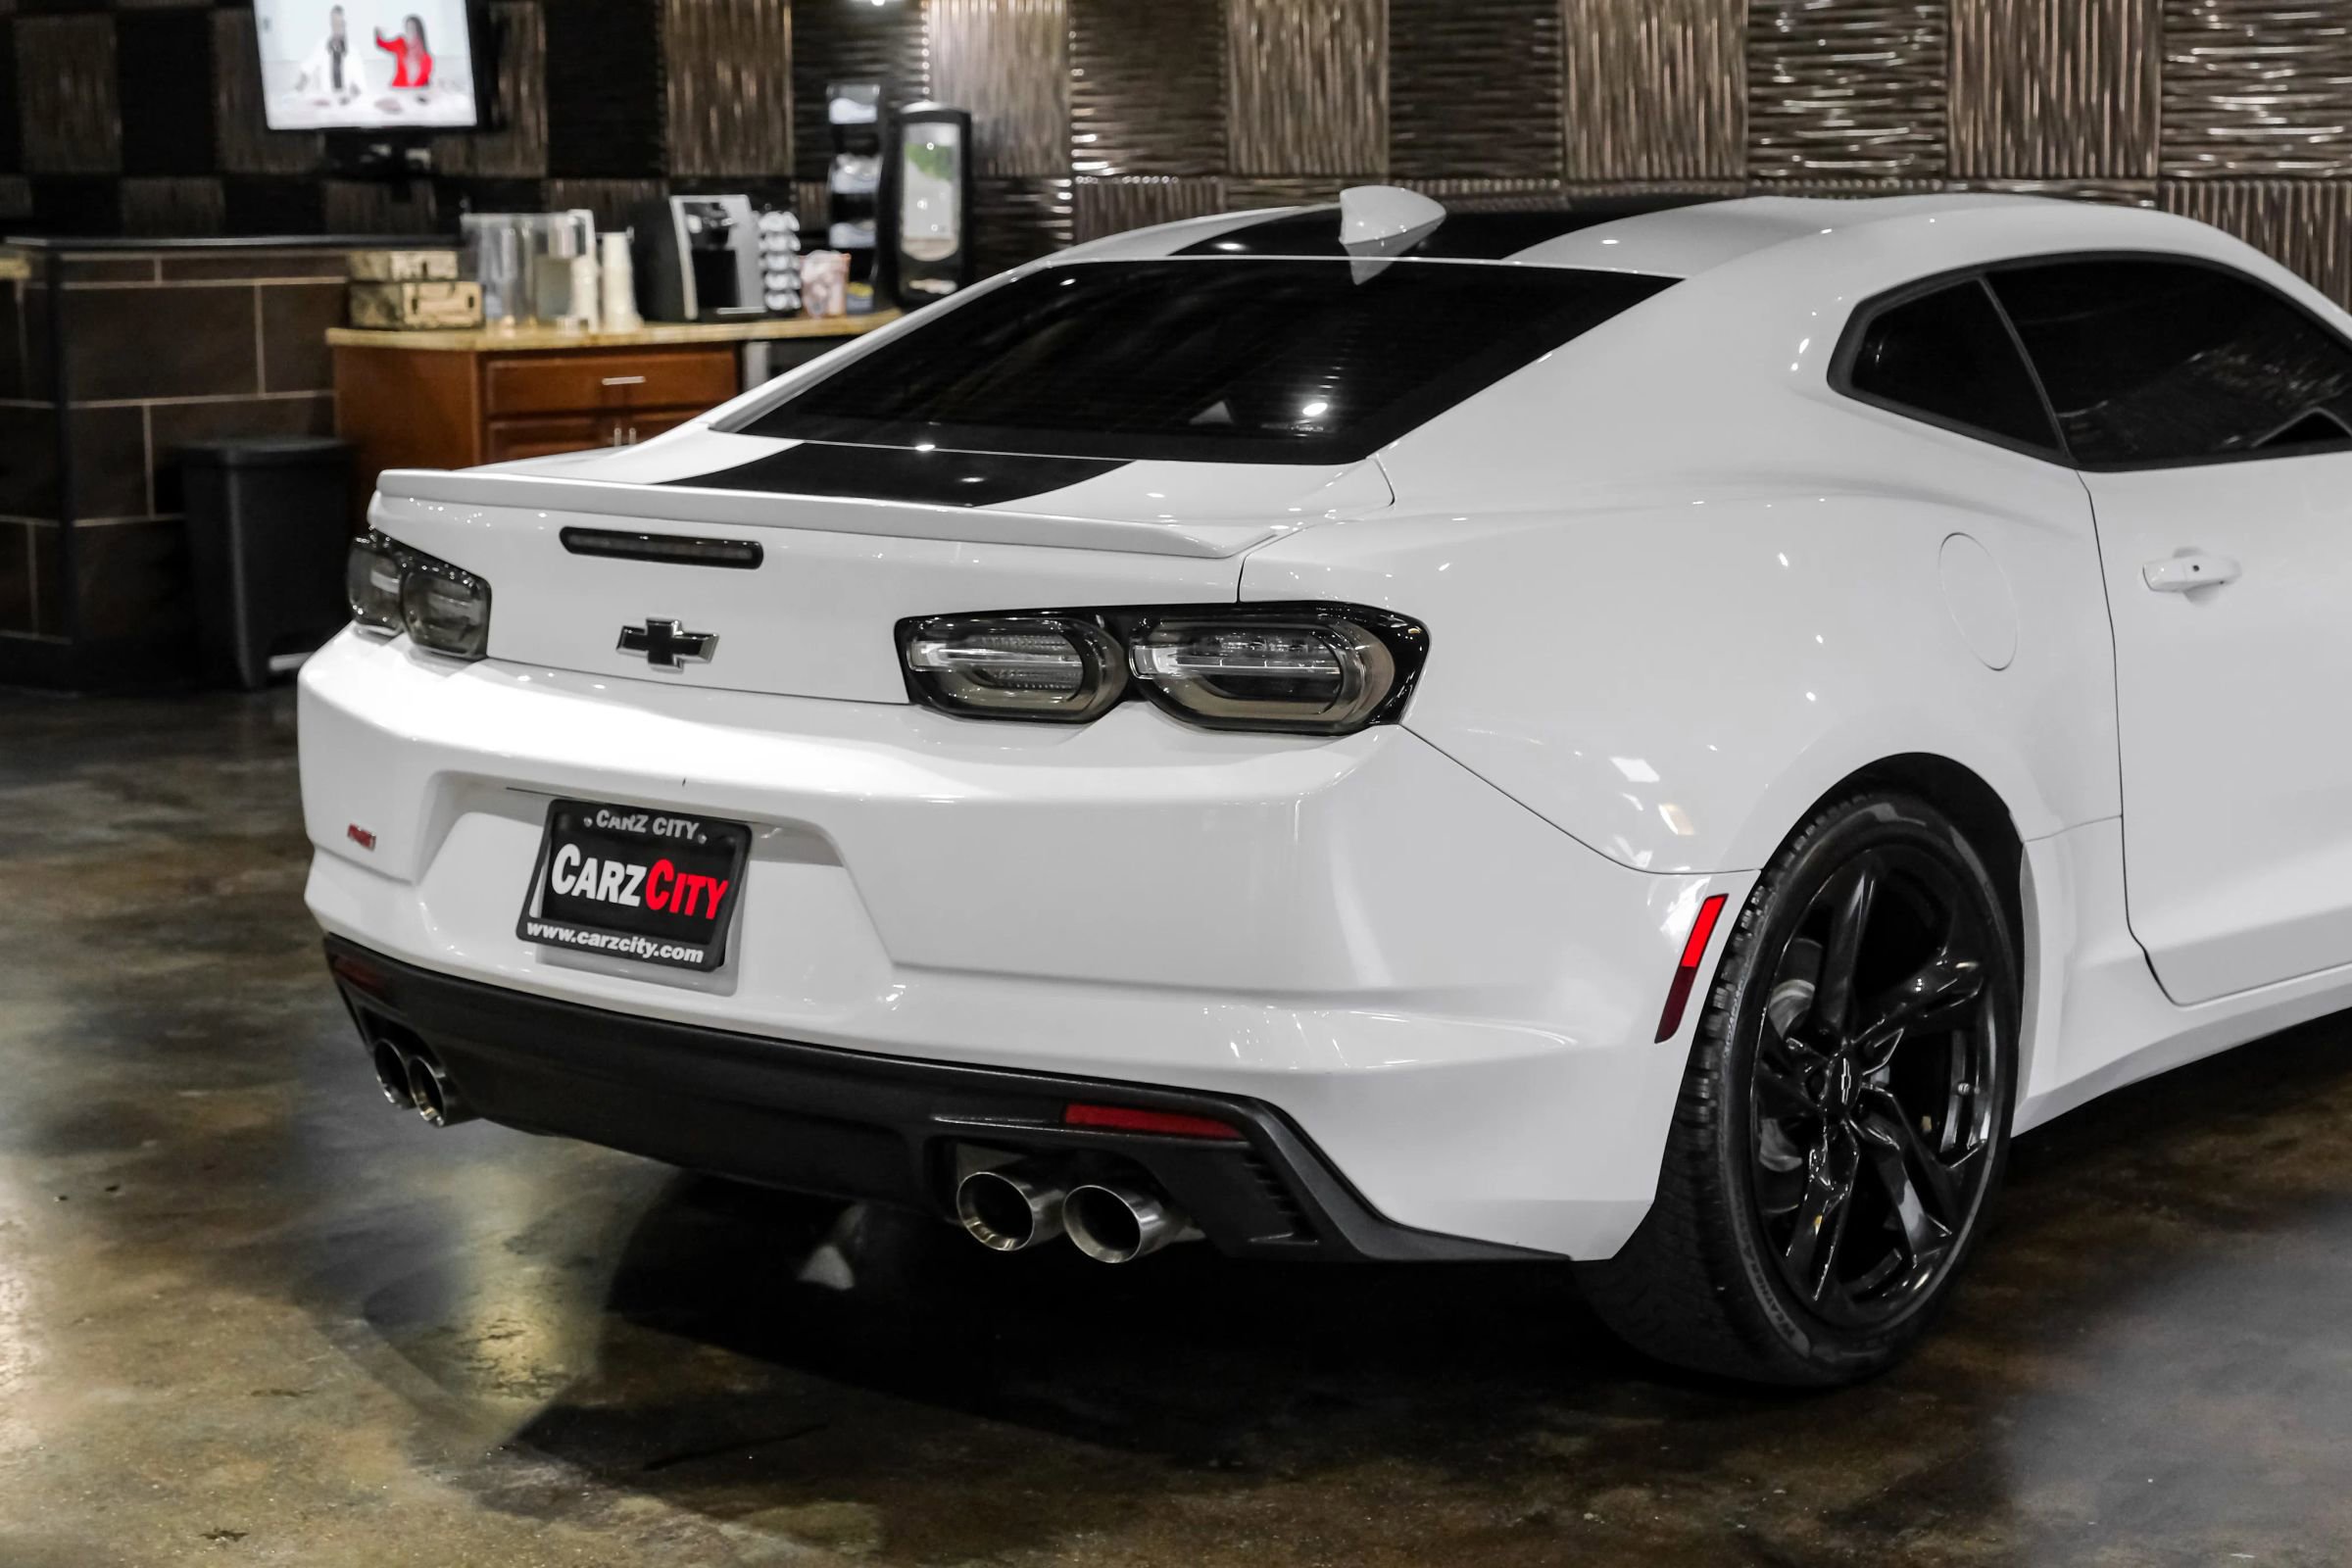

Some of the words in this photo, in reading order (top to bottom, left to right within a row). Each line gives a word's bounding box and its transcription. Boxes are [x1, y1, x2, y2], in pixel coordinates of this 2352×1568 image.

[596, 809, 649, 833] CARZ
[653, 817, 700, 840] CITY
[526, 921, 705, 963] www.carzcity.com
